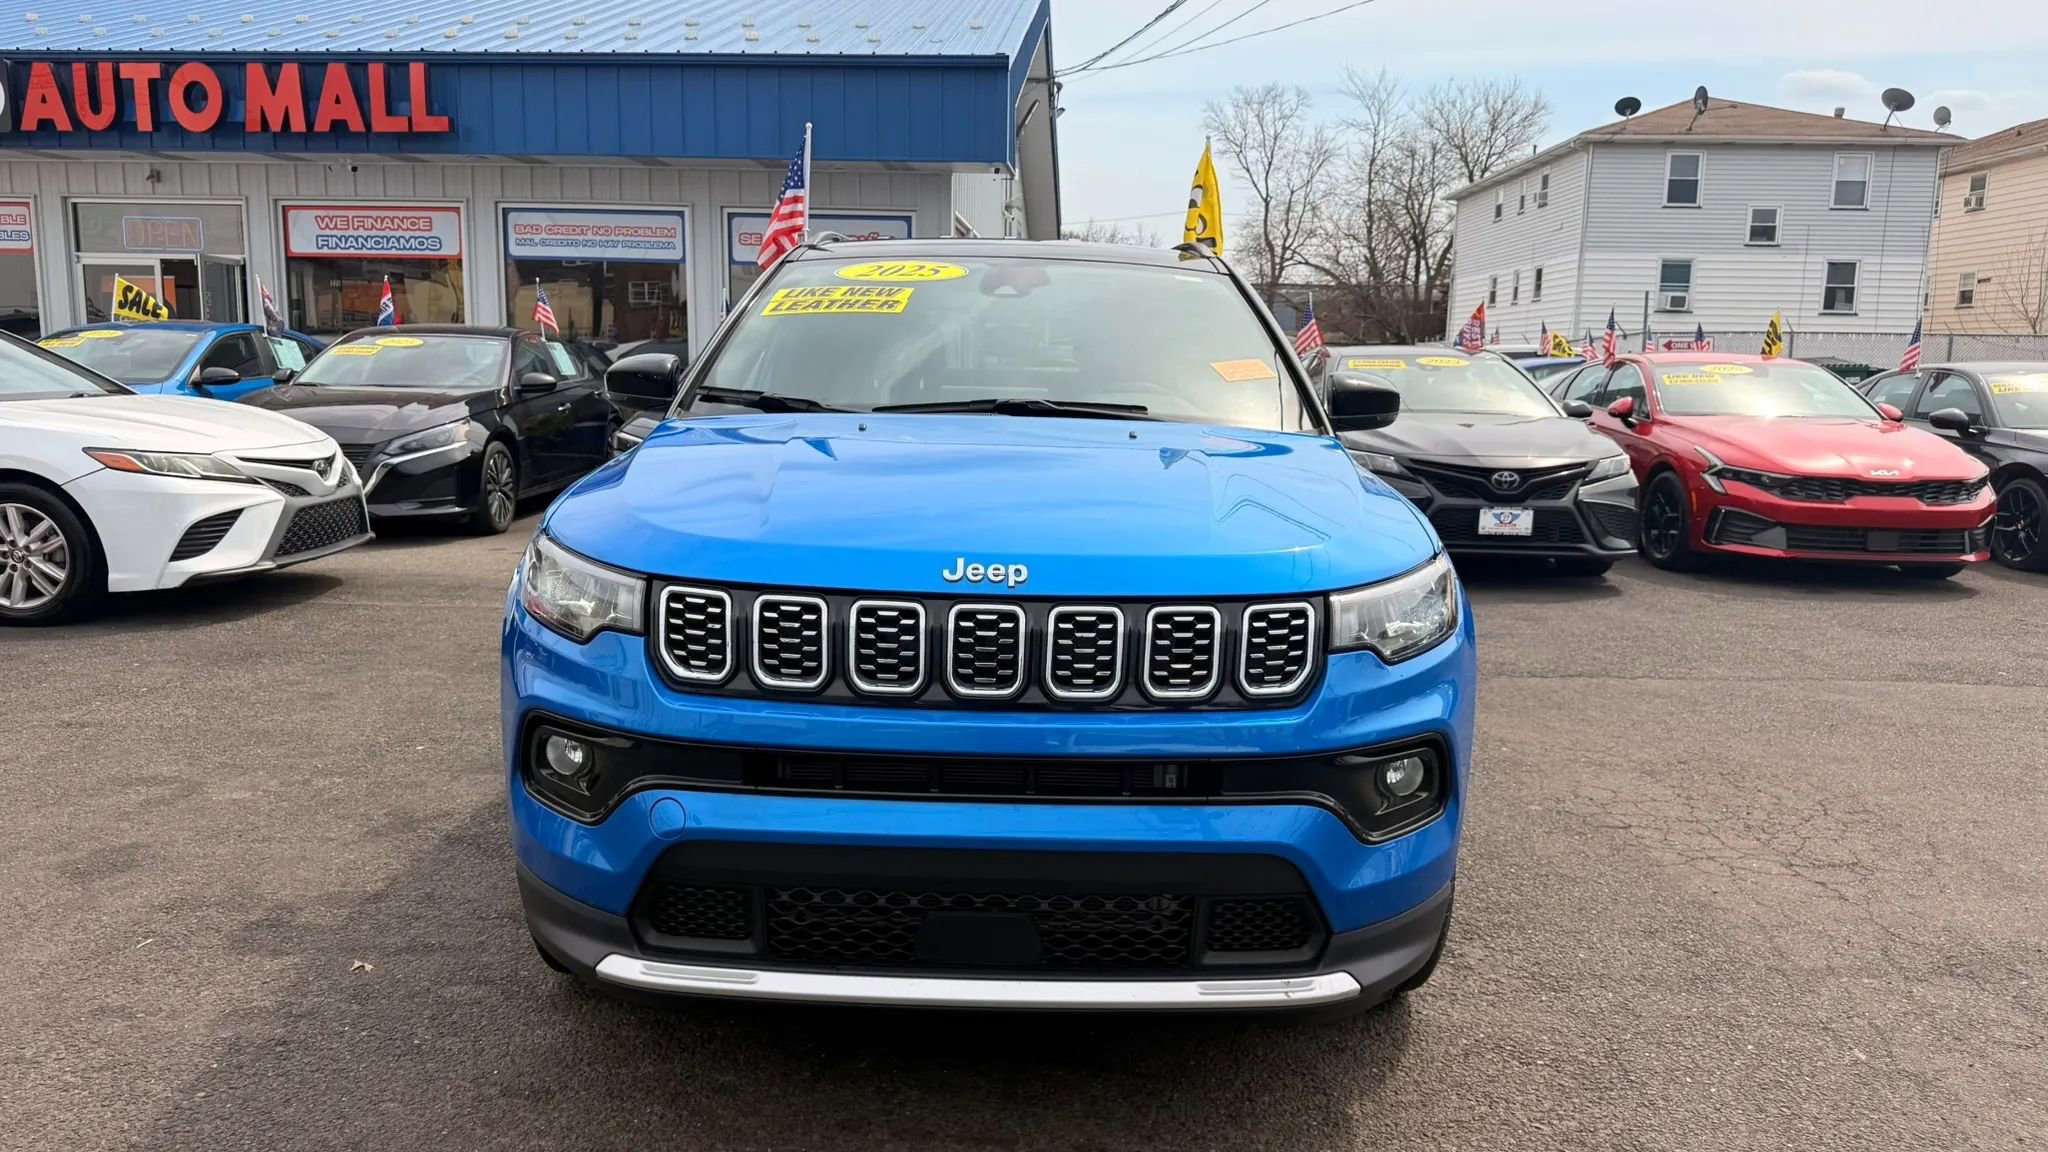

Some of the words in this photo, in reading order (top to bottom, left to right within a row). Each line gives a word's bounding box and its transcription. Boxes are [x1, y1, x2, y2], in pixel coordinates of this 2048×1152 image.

[20, 62, 223, 132] AUTO
[245, 62, 450, 133] MALL
[315, 215, 350, 231] WE
[352, 216, 432, 232] FINANCE
[127, 221, 200, 248] OPEN
[514, 224, 543, 235] BAD
[545, 225, 590, 236] CREDIT
[592, 225, 613, 236] NO
[614, 226, 677, 238] PROBLEM
[316, 235, 442, 250] FINANCIAMOS
[516, 238, 538, 247] MAL
[540, 238, 581, 248] CREDITO
[582, 239, 597, 248] NO
[599, 240, 620, 248] HAY
[622, 240, 677, 249] PROBLEMA
[738, 232, 763, 246] SE
[857, 264, 949, 278] 2025
[782, 287, 840, 299] LIKE
[842, 287, 903, 299] NEW
[118, 284, 163, 319] SALE
[769, 299, 900, 312] LEATHER
[1671, 341, 1688, 350] ONE
[942, 557, 1029, 588] Jeep
